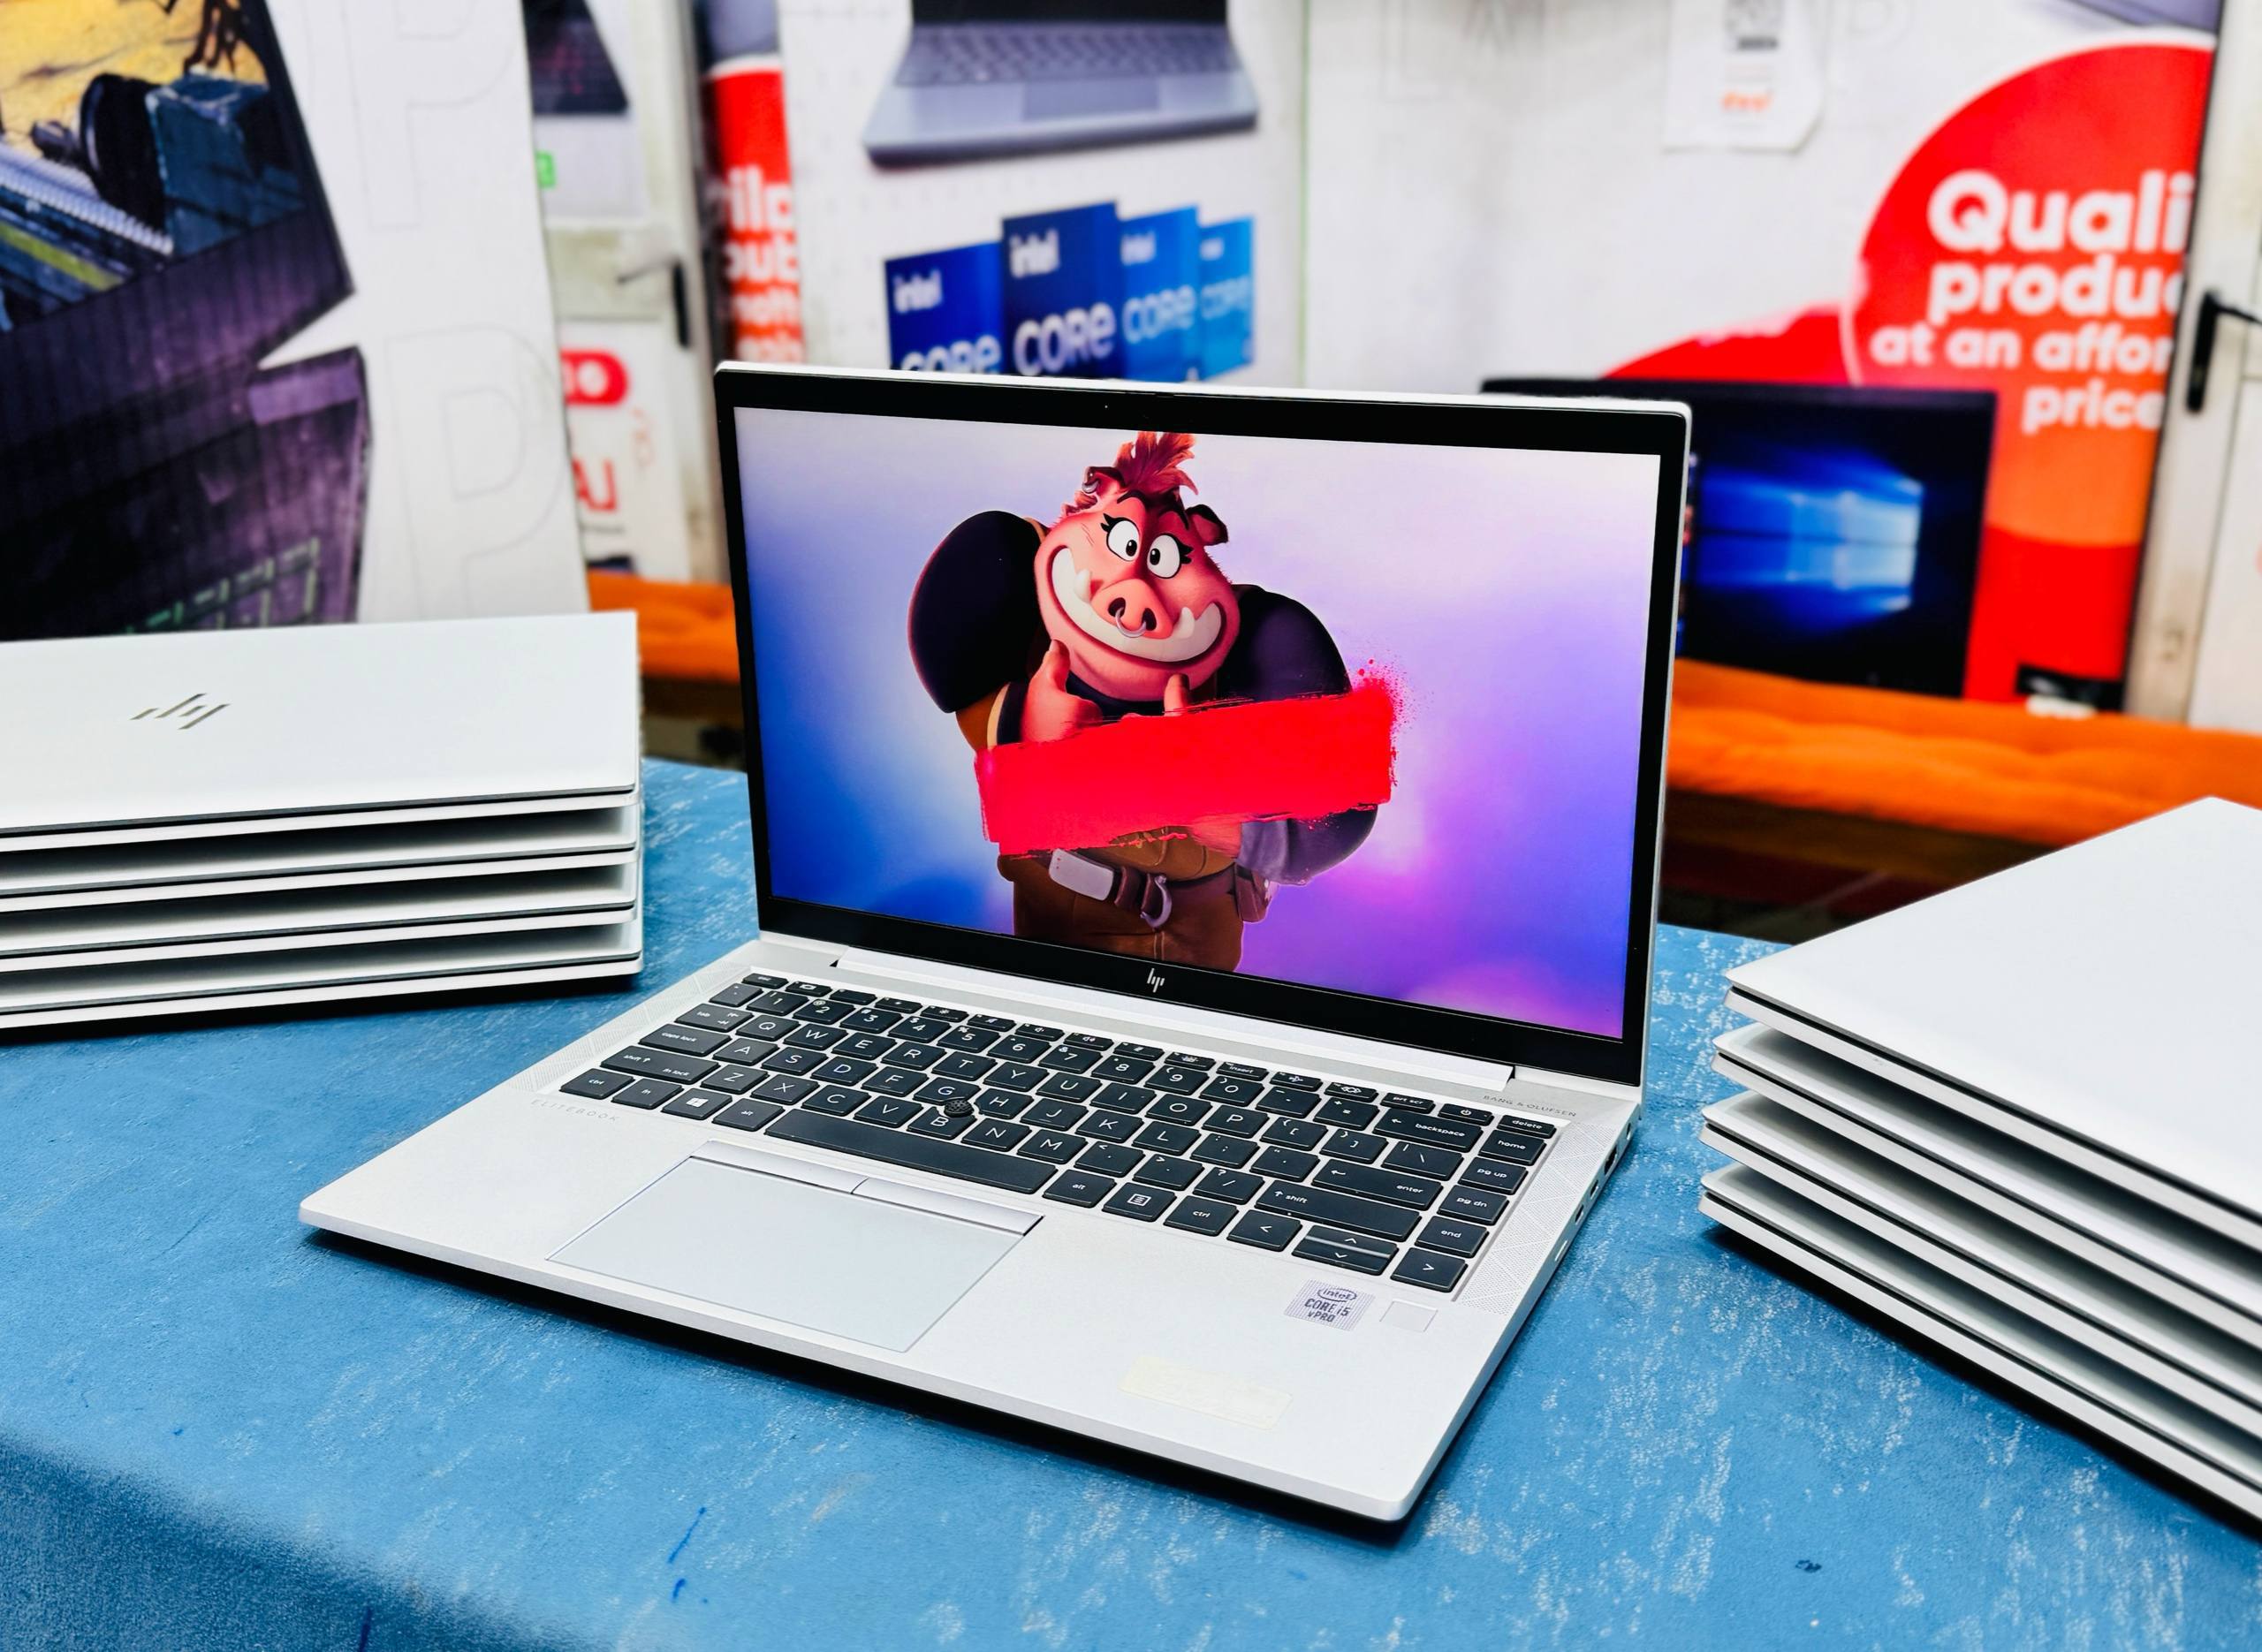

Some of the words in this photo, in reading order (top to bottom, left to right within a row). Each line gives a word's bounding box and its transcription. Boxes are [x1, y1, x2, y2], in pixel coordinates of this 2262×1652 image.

[1927, 169, 2196, 254] Quali
[1869, 322, 1934, 366] at
[1945, 329, 2022, 368] an
[806, 1030, 828, 1039] W
[859, 1040, 872, 1049] E
[904, 1050, 921, 1058] R
[724, 1072, 743, 1081] Z
[774, 1083, 794, 1092] X
[1060, 1080, 1078, 1089] U
[990, 1097, 1008, 1106] H
[530, 1099, 620, 1121] ELITEBOOK
[883, 1104, 898, 1113] V
[930, 1115, 949, 1126] B
[1099, 1119, 1118, 1129] K
[1512, 1118, 1543, 1130] delete
[986, 1128, 1006, 1138] N
[1415, 1123, 1466, 1137] backspace
[1158, 1131, 1168, 1141] L
[1040, 1139, 1062, 1149] M
[1499, 1140, 1525, 1149] home
[1323, 1288, 1354, 1300] intel
[1304, 1299, 1336, 1312] CORE
[1337, 1306, 1351, 1316] i5
[1308, 1311, 1335, 1322] vPRO
